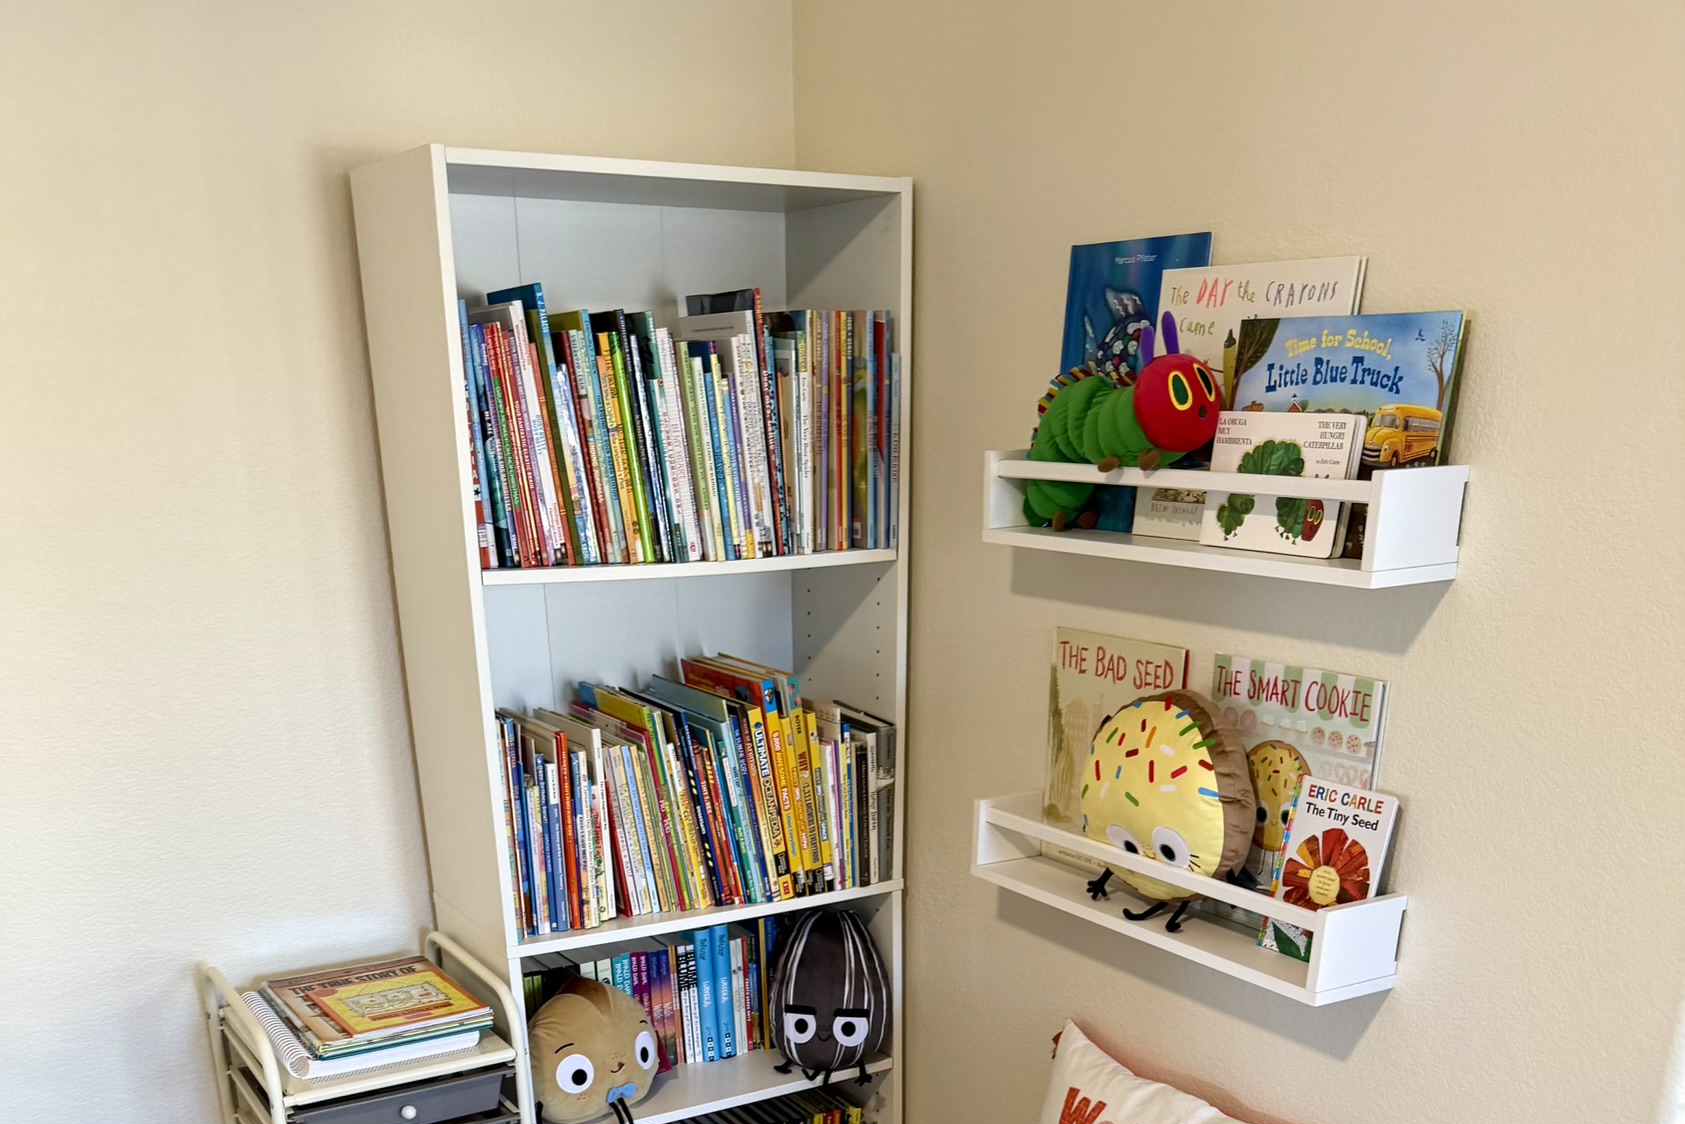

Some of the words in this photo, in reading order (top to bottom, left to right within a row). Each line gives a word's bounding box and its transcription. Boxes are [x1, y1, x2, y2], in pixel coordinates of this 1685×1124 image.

[1171, 286, 1189, 305] The
[1196, 276, 1234, 308] DAY
[1237, 279, 1256, 303] the
[1265, 280, 1339, 308] CRAYONS
[538, 308, 549, 333] PALACIO
[1285, 337, 1317, 358] Time
[1321, 329, 1343, 348] for
[1345, 328, 1392, 360] School,
[1265, 362, 1308, 393] Little
[1312, 356, 1348, 386] Blue
[1351, 355, 1404, 394] Truck
[516, 413, 527, 447] FANTASTIC
[1318, 421, 1331, 429] THE
[1332, 421, 1347, 430] VERY
[1319, 431, 1345, 440] HUNGRY
[673, 434, 682, 448] MY
[1303, 441, 1344, 450] CATERPILLAR
[522, 448, 531, 471] ELASTIC
[676, 453, 686, 479] HEART
[526, 472, 534, 488] BRAIN
[1059, 640, 1088, 675] THE
[1095, 645, 1127, 684] BAD
[1133, 659, 1174, 690] SEED
[1216, 664, 1242, 697] THE
[1247, 670, 1301, 710] SMART
[1305, 680, 1372, 723] COOKIE
[794, 715, 802, 734] BOYER
[745, 742, 758, 776] Animals
[754, 729, 769, 776] ULTIMATE
[775, 752, 786, 786] AWESOME
[704, 802, 712, 813] REX
[762, 777, 781, 839] OCEANPEDIA
[780, 788, 790, 809] FACTS
[1308, 784, 1338, 803] ERIC
[1341, 792, 1384, 815] CARLE
[1306, 802, 1325, 817] The
[1327, 807, 1350, 826] Tiny
[1351, 814, 1379, 831] Seed
[355, 970, 399, 983] STORY
[399, 965, 418, 975] OF
[677, 954, 688, 991] BLUME
[685, 952, 697, 989] BLUME
